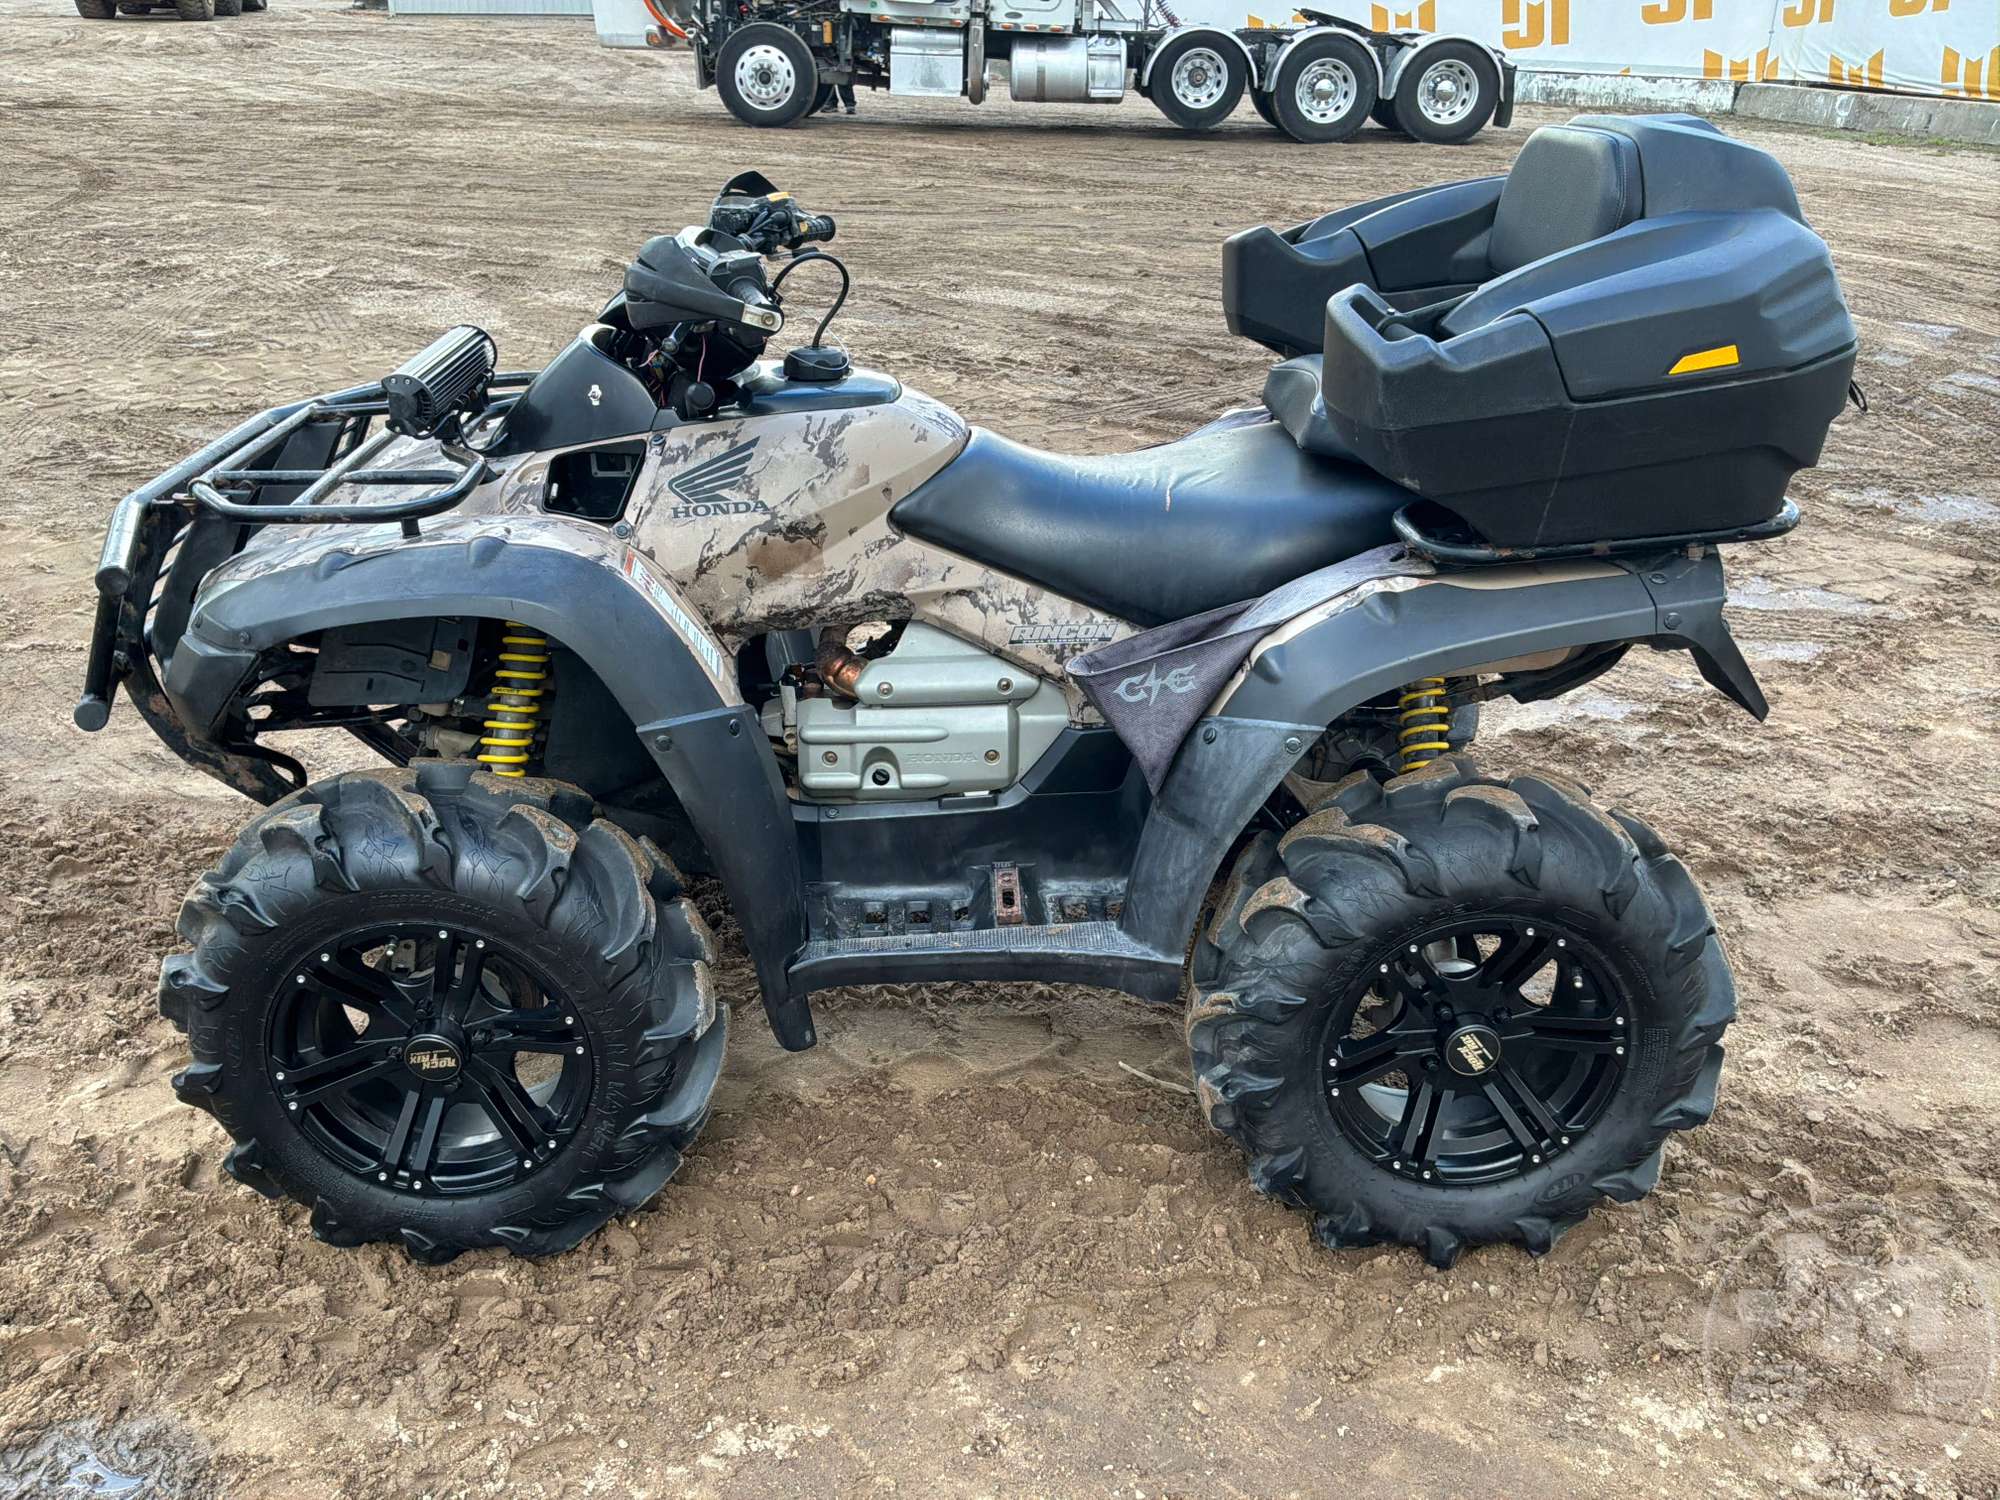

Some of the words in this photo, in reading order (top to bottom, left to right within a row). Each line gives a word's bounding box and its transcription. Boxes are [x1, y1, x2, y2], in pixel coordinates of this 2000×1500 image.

[671, 500, 770, 518] HONDA
[1009, 623, 1119, 643] RINCON
[905, 752, 978, 764] HONDA
